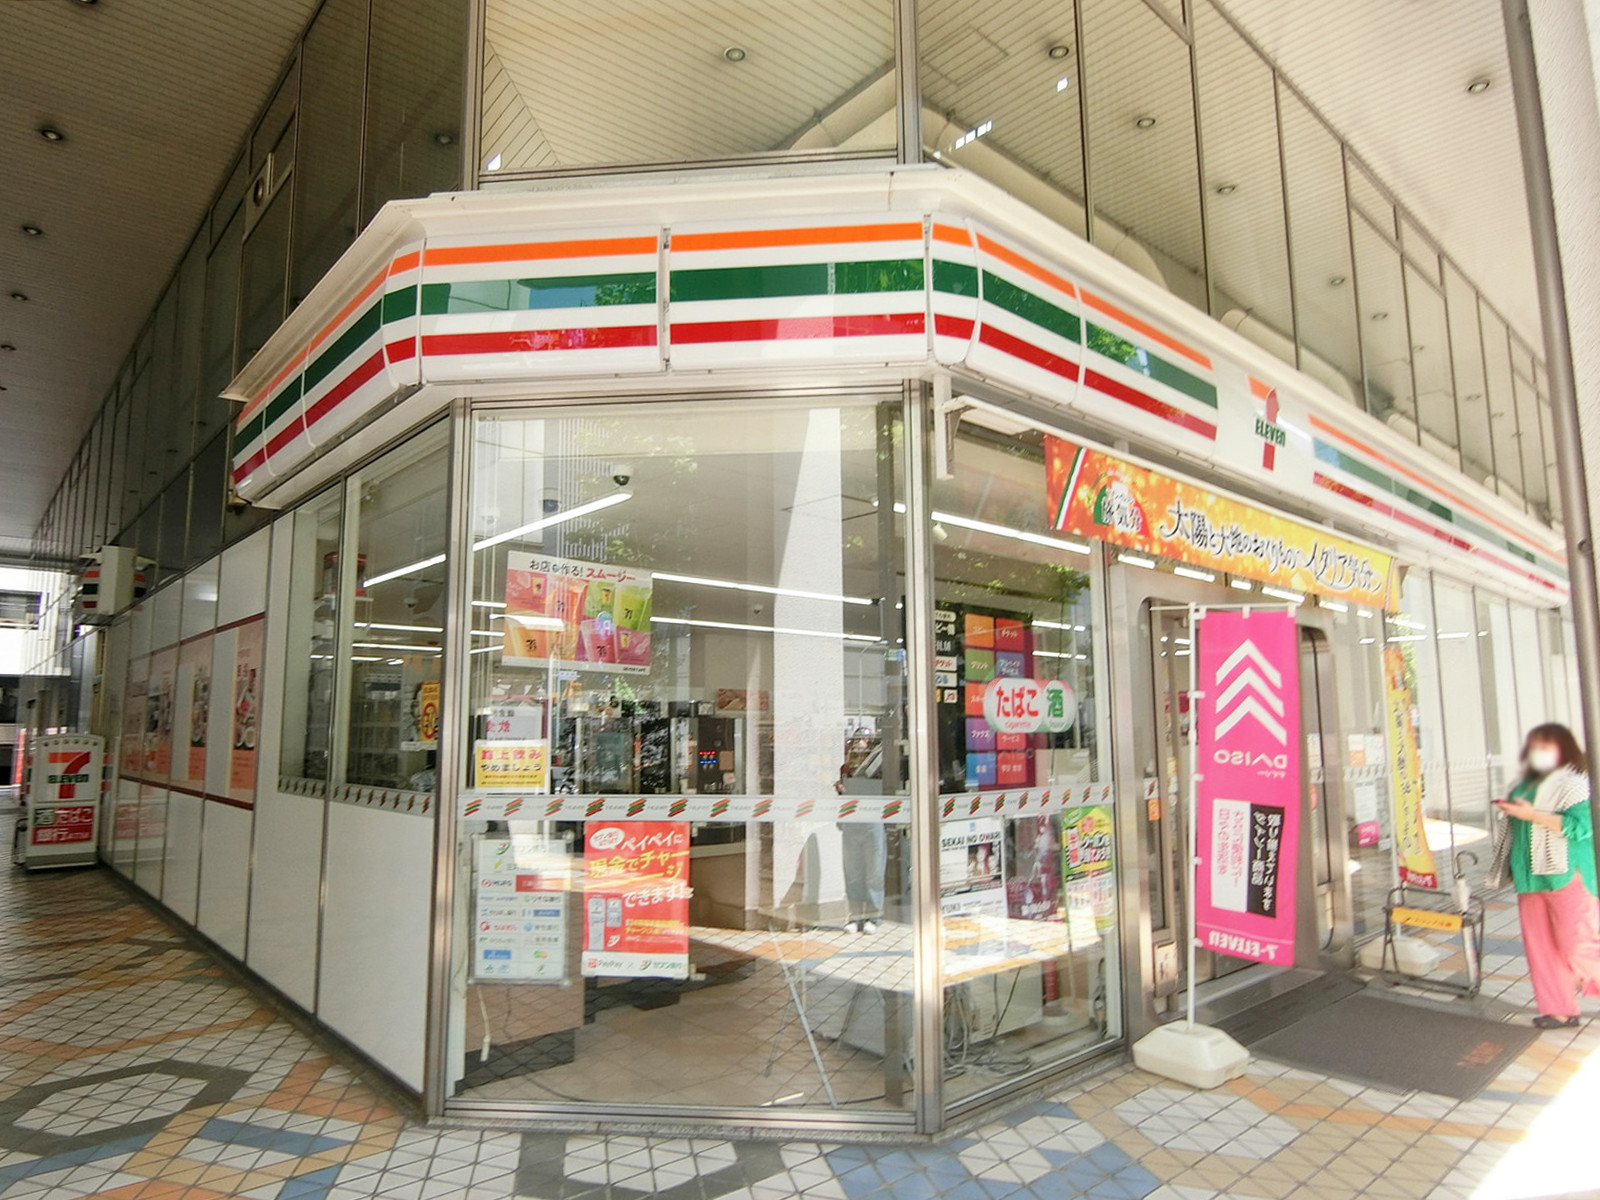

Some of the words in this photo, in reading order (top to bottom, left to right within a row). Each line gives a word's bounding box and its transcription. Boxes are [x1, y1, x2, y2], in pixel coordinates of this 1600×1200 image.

[995, 686, 1040, 718] たばこ
[1046, 688, 1064, 718] 酒
[55, 807, 93, 825] たばこ
[941, 835, 966, 849] SEKAI
